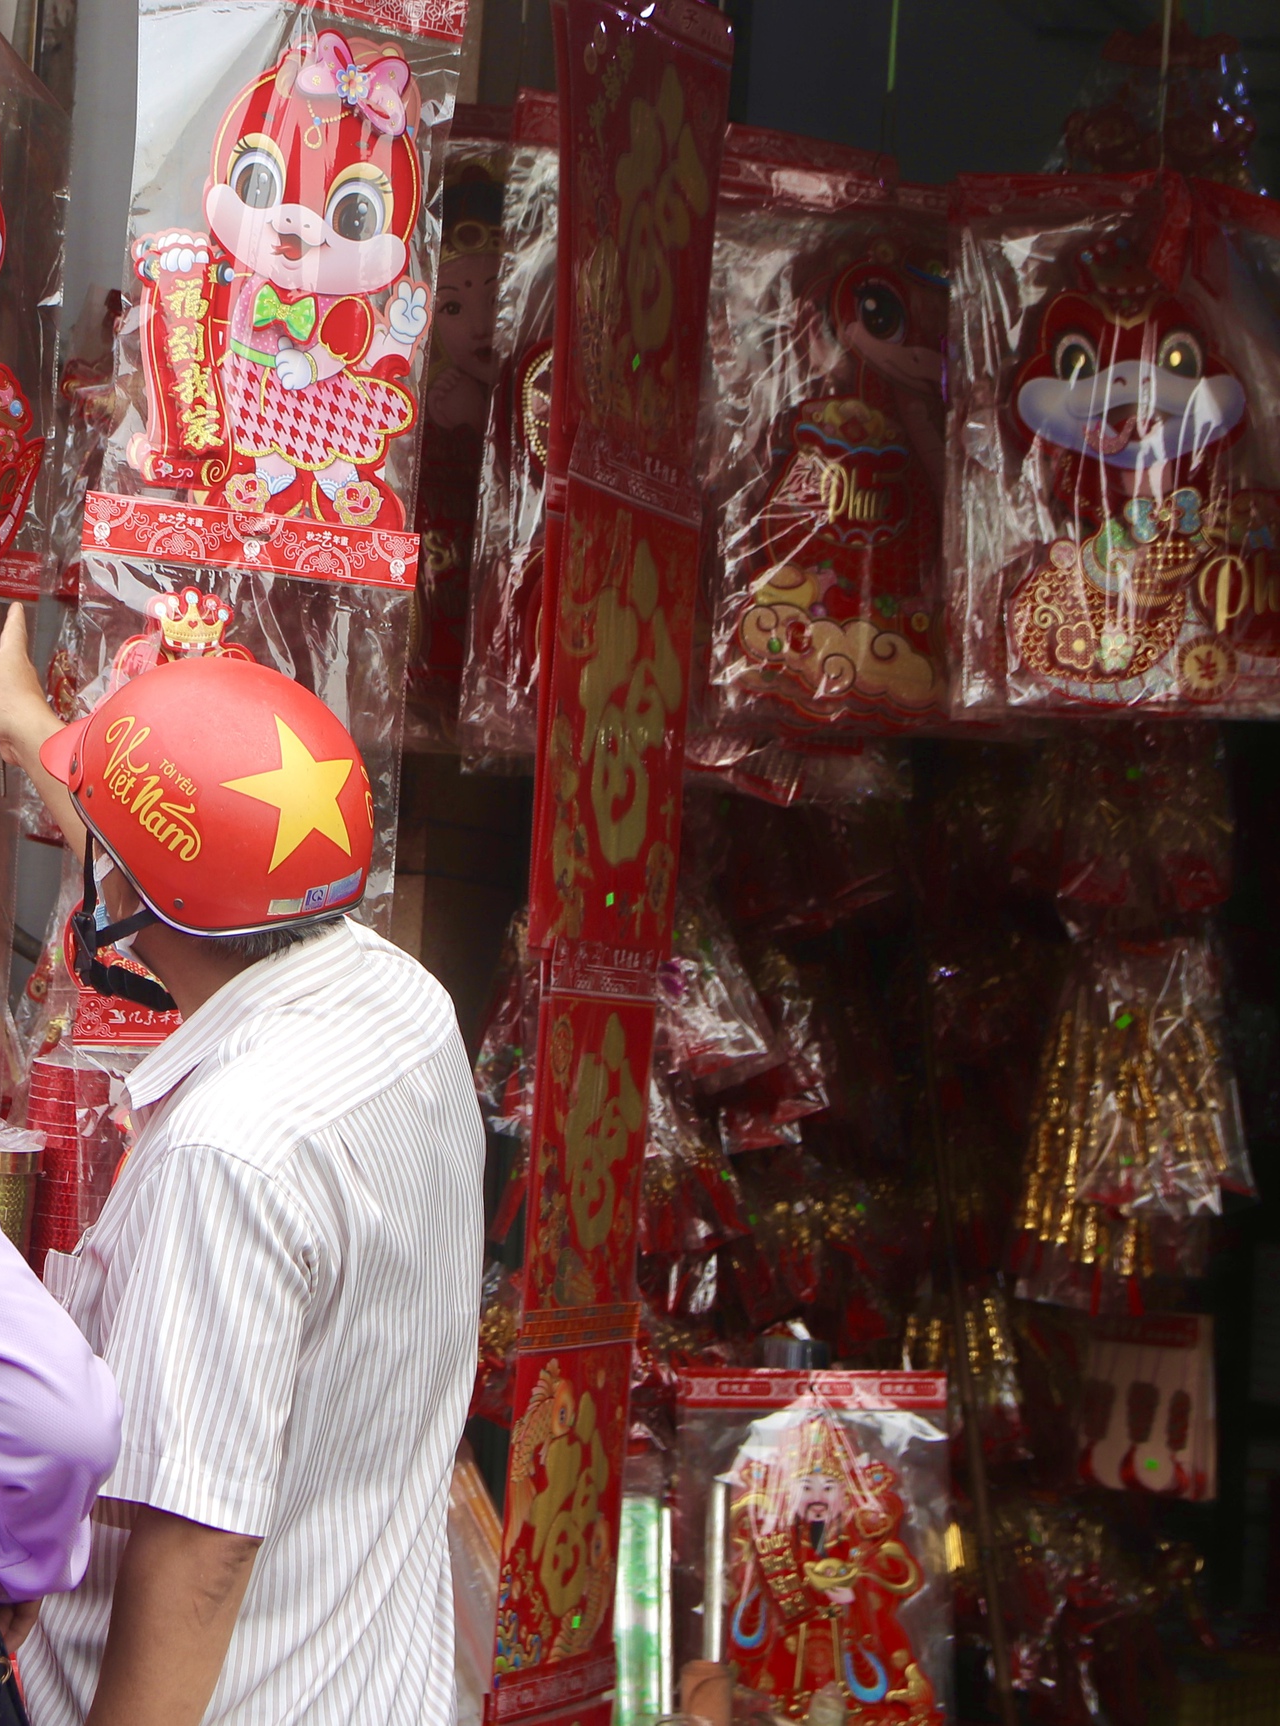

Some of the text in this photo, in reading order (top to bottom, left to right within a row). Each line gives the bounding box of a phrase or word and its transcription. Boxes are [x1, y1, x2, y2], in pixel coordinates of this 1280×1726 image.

[164, 278, 224, 450] 福到我家
[103, 716, 202, 862] Việt Nam
[158, 758, 198, 797] TÔI YÊU
